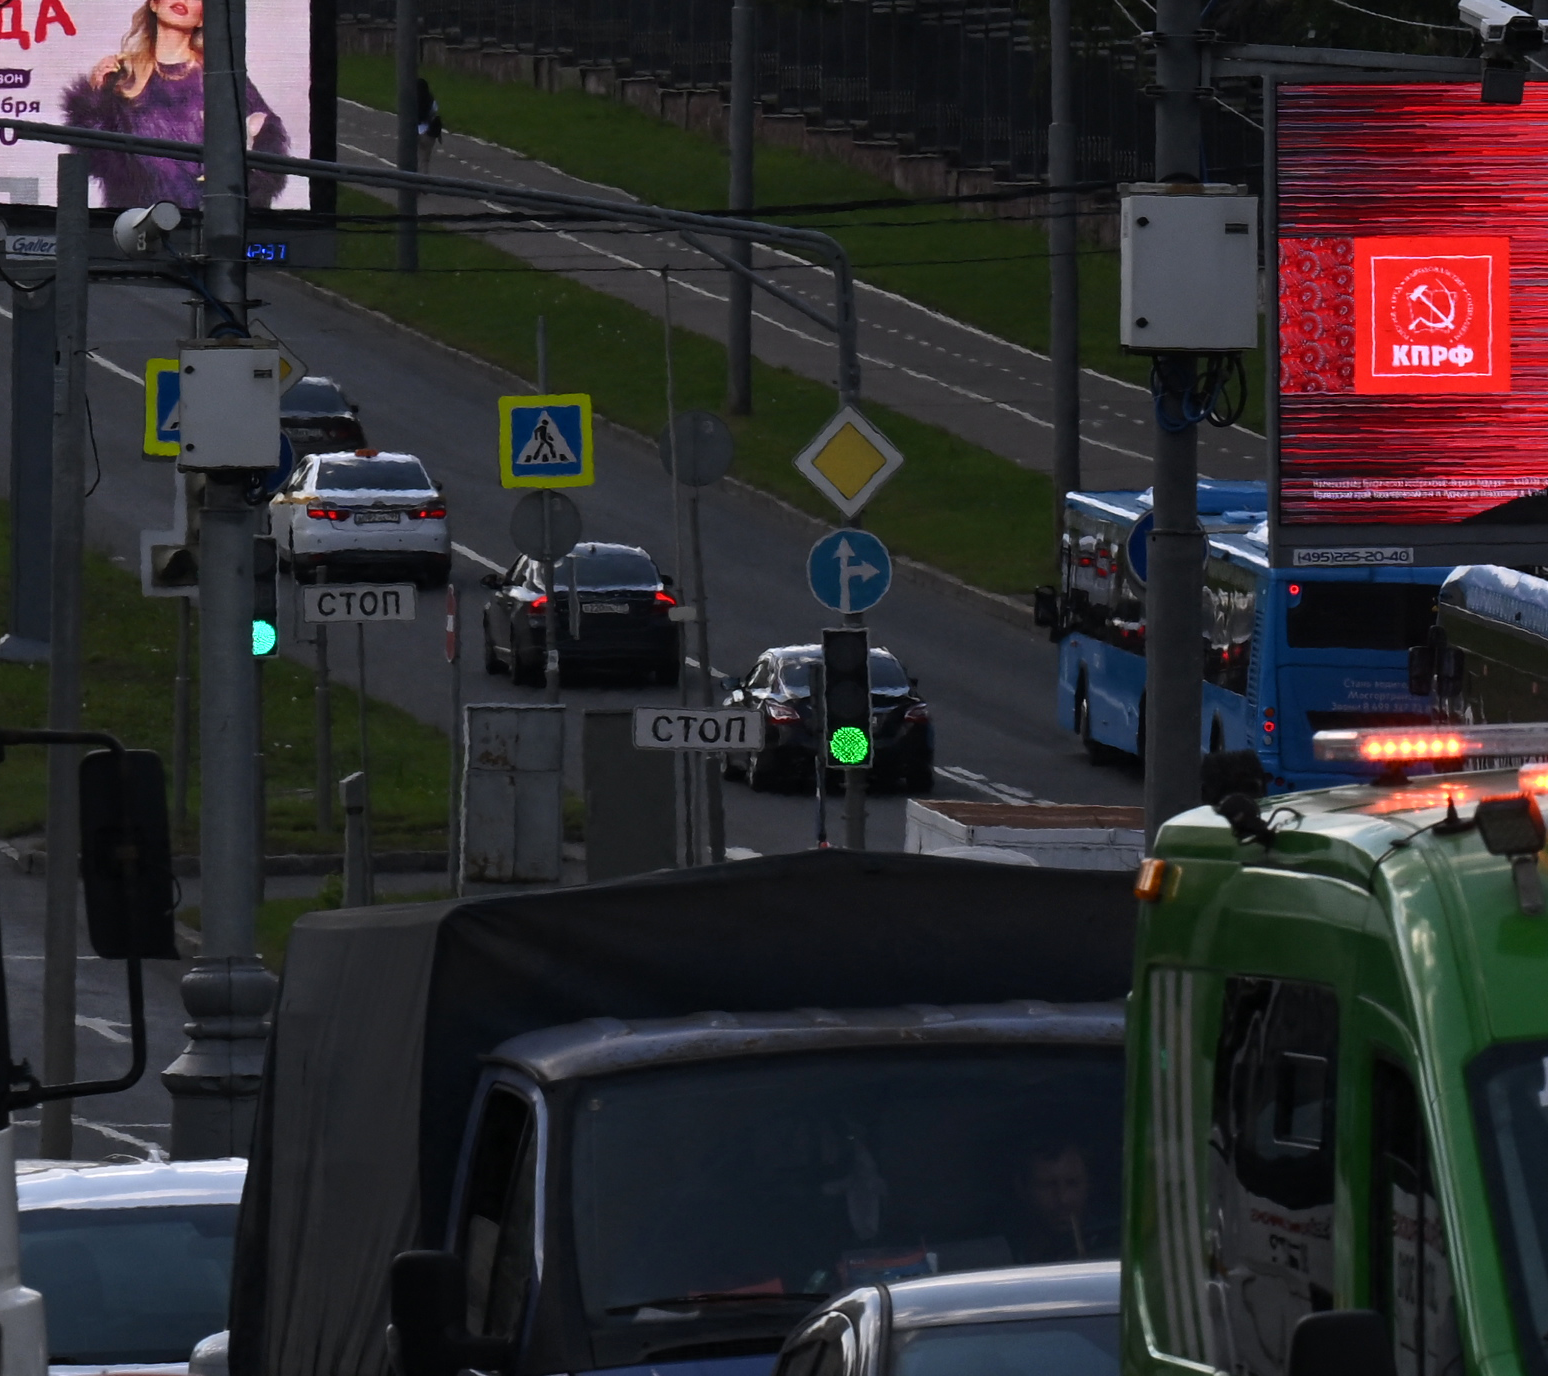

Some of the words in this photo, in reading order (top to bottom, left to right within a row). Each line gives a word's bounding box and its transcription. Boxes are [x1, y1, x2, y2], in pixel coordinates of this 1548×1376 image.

[1392, 344, 1474, 367] КПРФ
[318, 591, 400, 616] СТОП
[652, 716, 745, 742] СТОП
